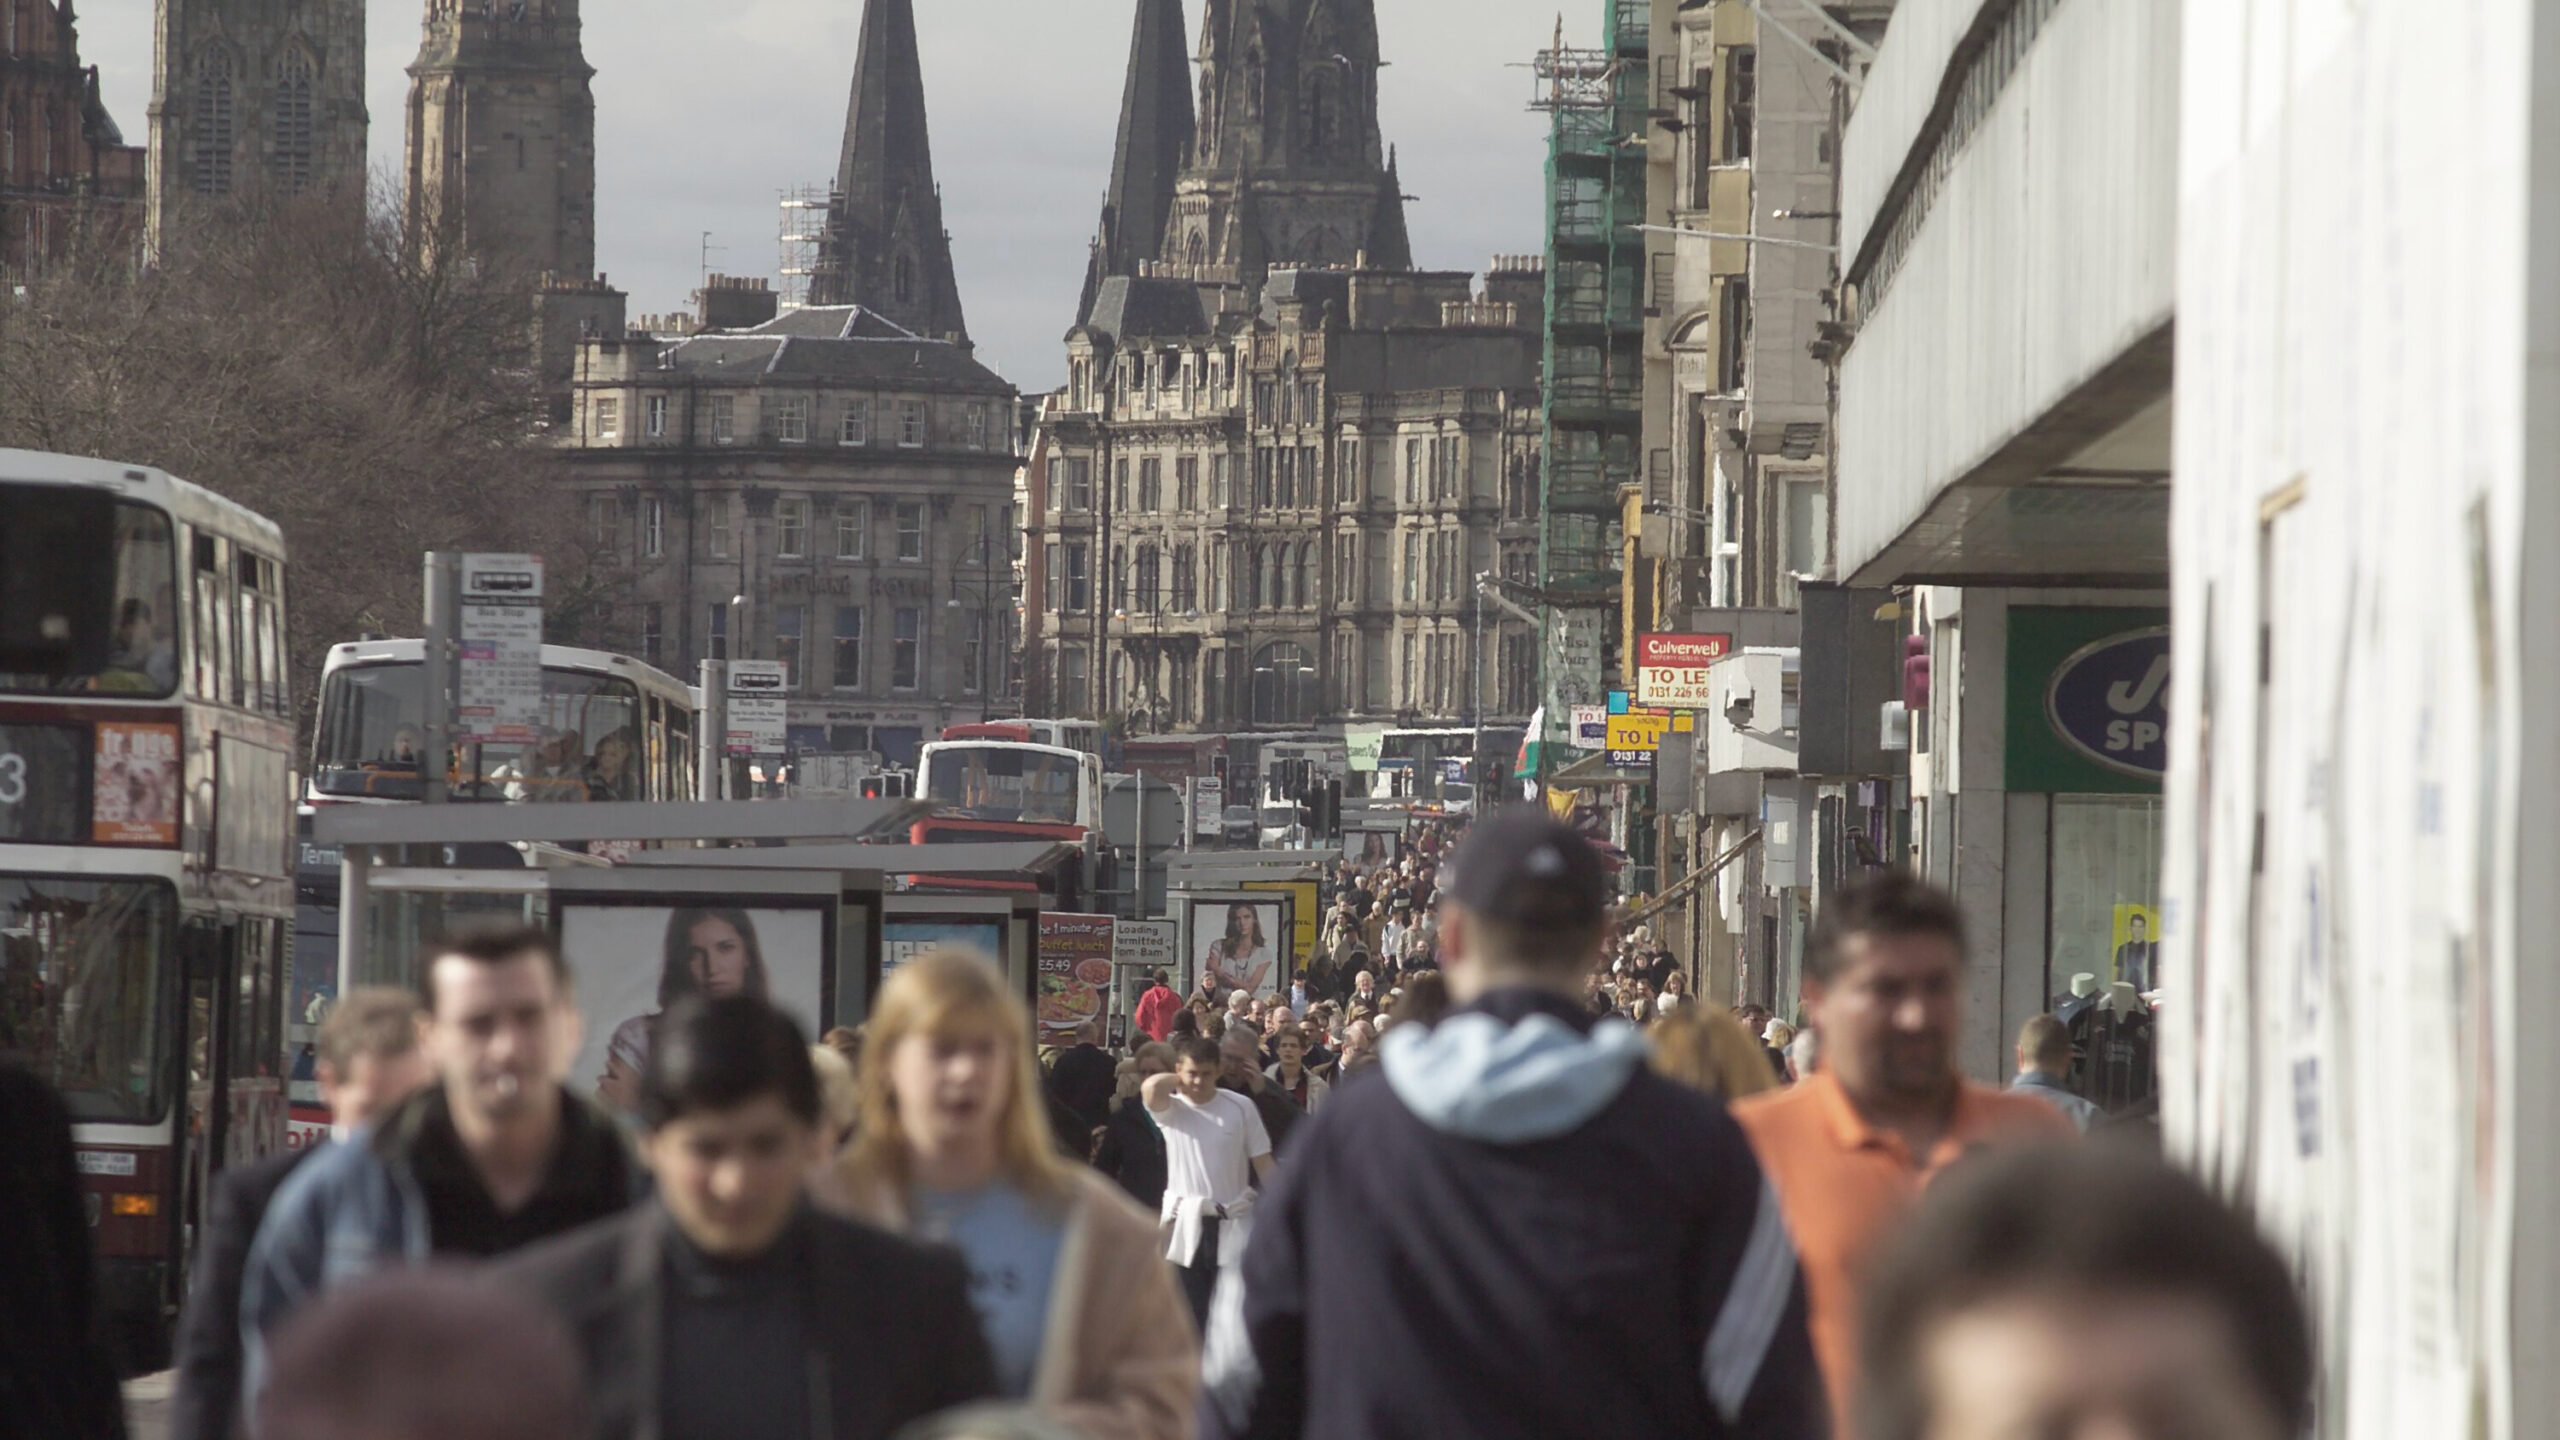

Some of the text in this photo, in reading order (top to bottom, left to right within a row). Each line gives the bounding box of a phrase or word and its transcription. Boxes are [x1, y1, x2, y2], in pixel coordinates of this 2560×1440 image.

[1648, 640, 1719, 656] Culverwell
[1649, 669, 1675, 684] TO
[2106, 653, 2170, 714] J
[1648, 686, 1670, 698] 0131
[1577, 713, 1593, 722] TO
[1616, 730, 1641, 745] TO
[2104, 719, 2168, 751] SP
[1613, 751, 1636, 761] 0131
[1118, 925, 1159, 936] Loading
